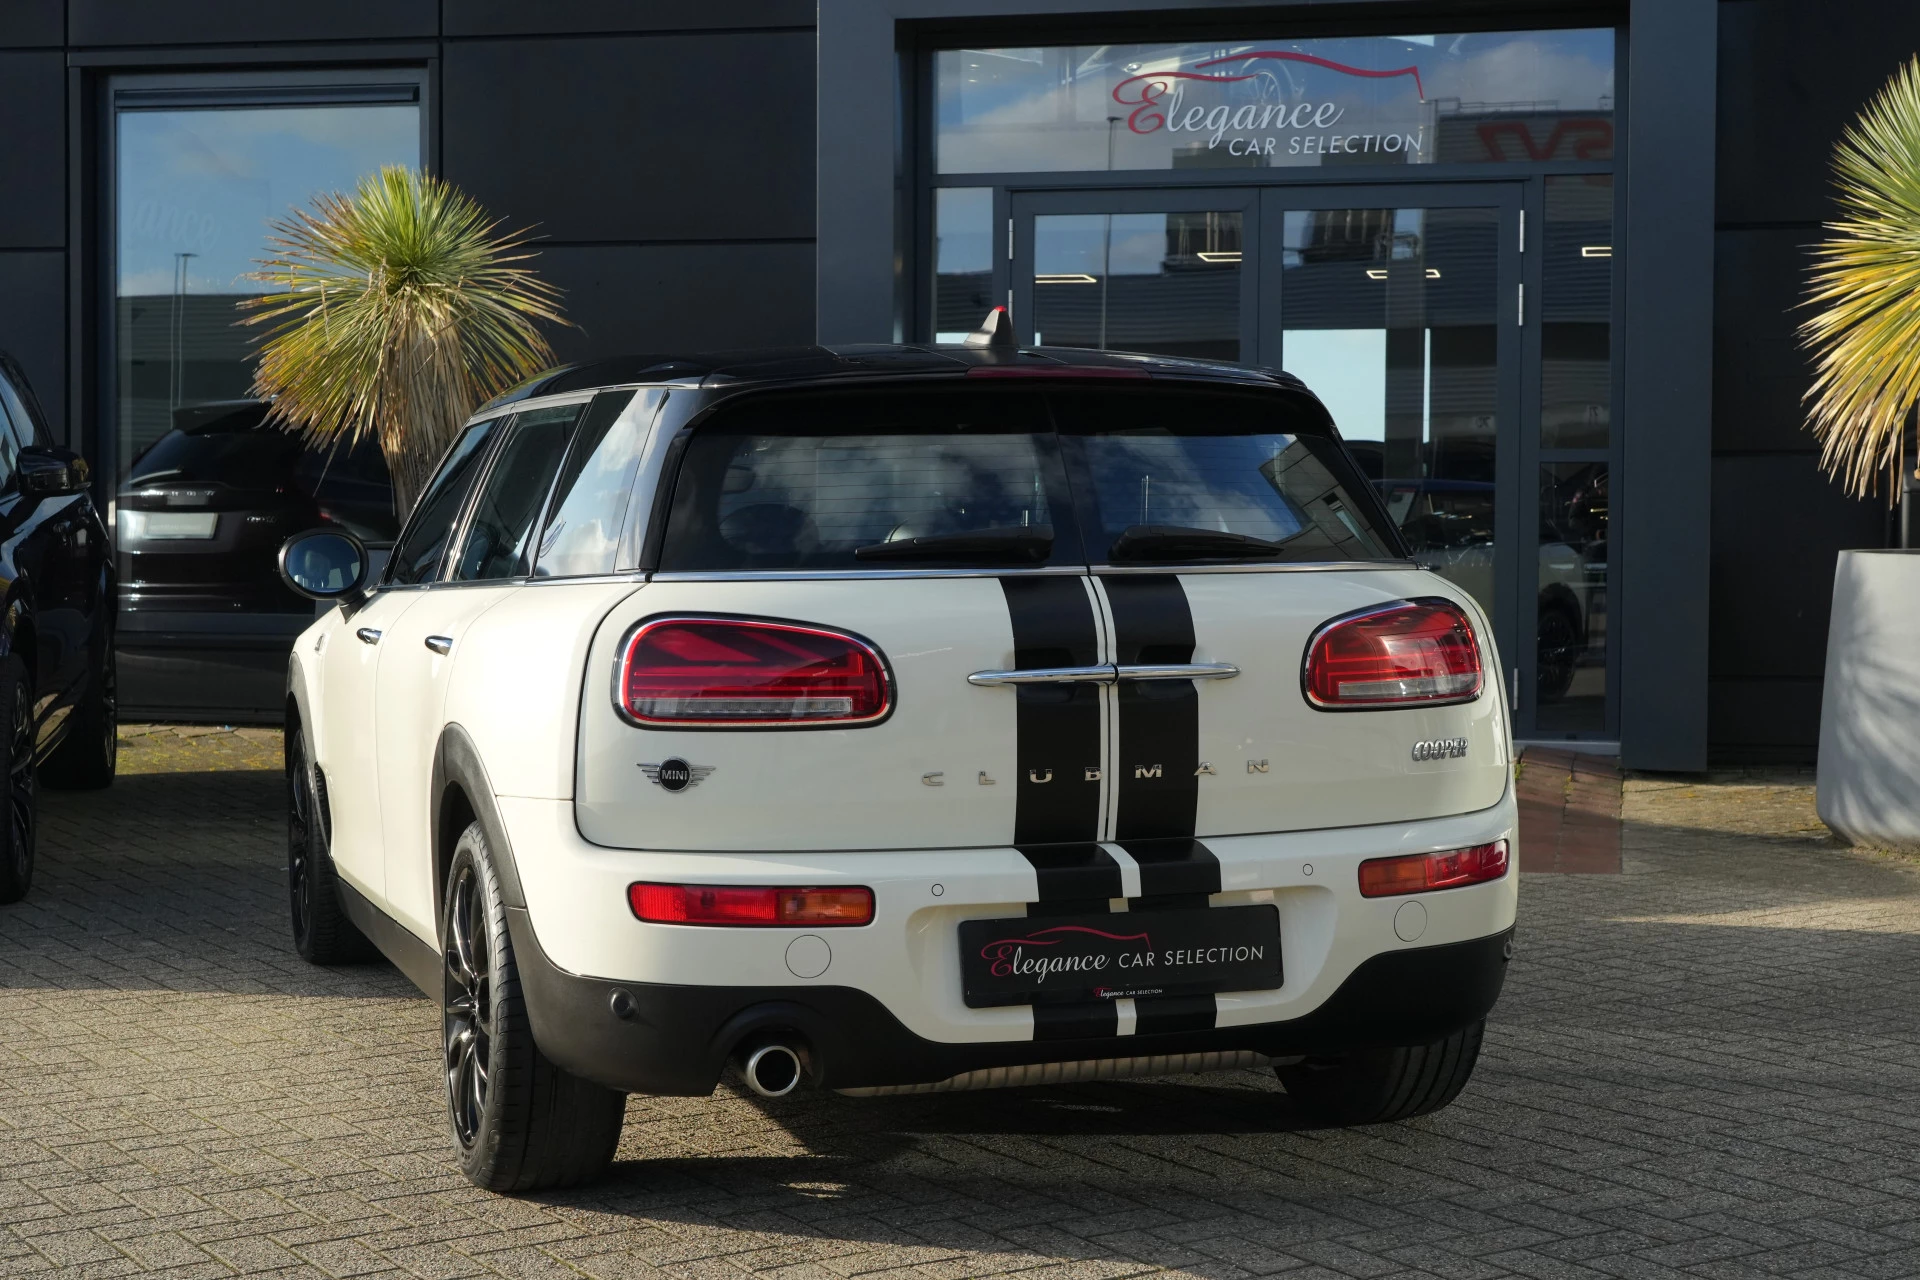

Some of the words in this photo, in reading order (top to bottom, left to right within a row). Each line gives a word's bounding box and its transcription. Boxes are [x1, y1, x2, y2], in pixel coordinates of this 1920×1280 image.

[1113, 76, 1345, 149] Elegance
[1228, 137, 1276, 156] CAR
[1287, 133, 1423, 156] SELECTION
[1411, 737, 1468, 762] COOPER
[661, 769, 688, 780] MINI
[921, 758, 1270, 787] CLUBMAN
[981, 940, 1110, 984] Elegance
[1118, 952, 1156, 969] CAR
[1163, 945, 1264, 967] SELECTION
